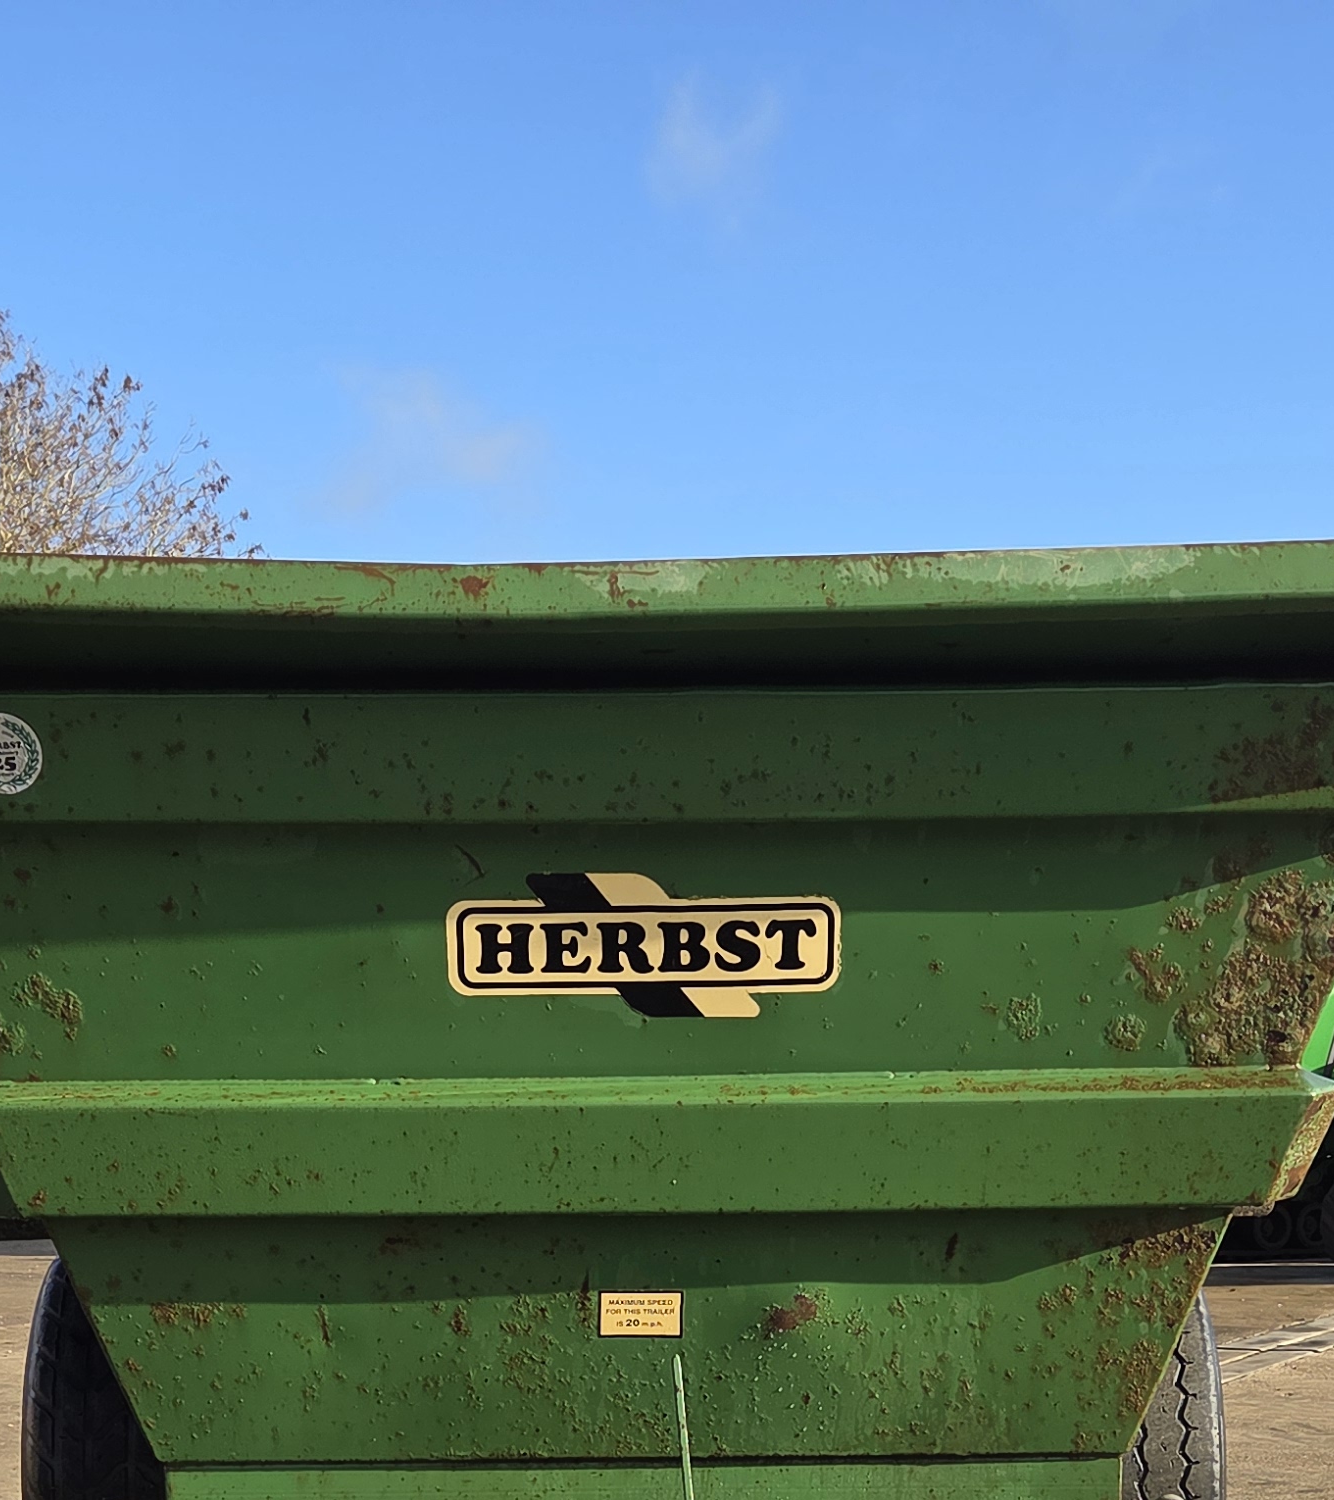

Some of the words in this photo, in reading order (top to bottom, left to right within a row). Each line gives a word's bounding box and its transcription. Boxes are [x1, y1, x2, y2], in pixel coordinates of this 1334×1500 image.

[474, 919, 818, 974] HERBST
[643, 1308, 675, 1316] TRAILER
[625, 1318, 640, 1327] 20
